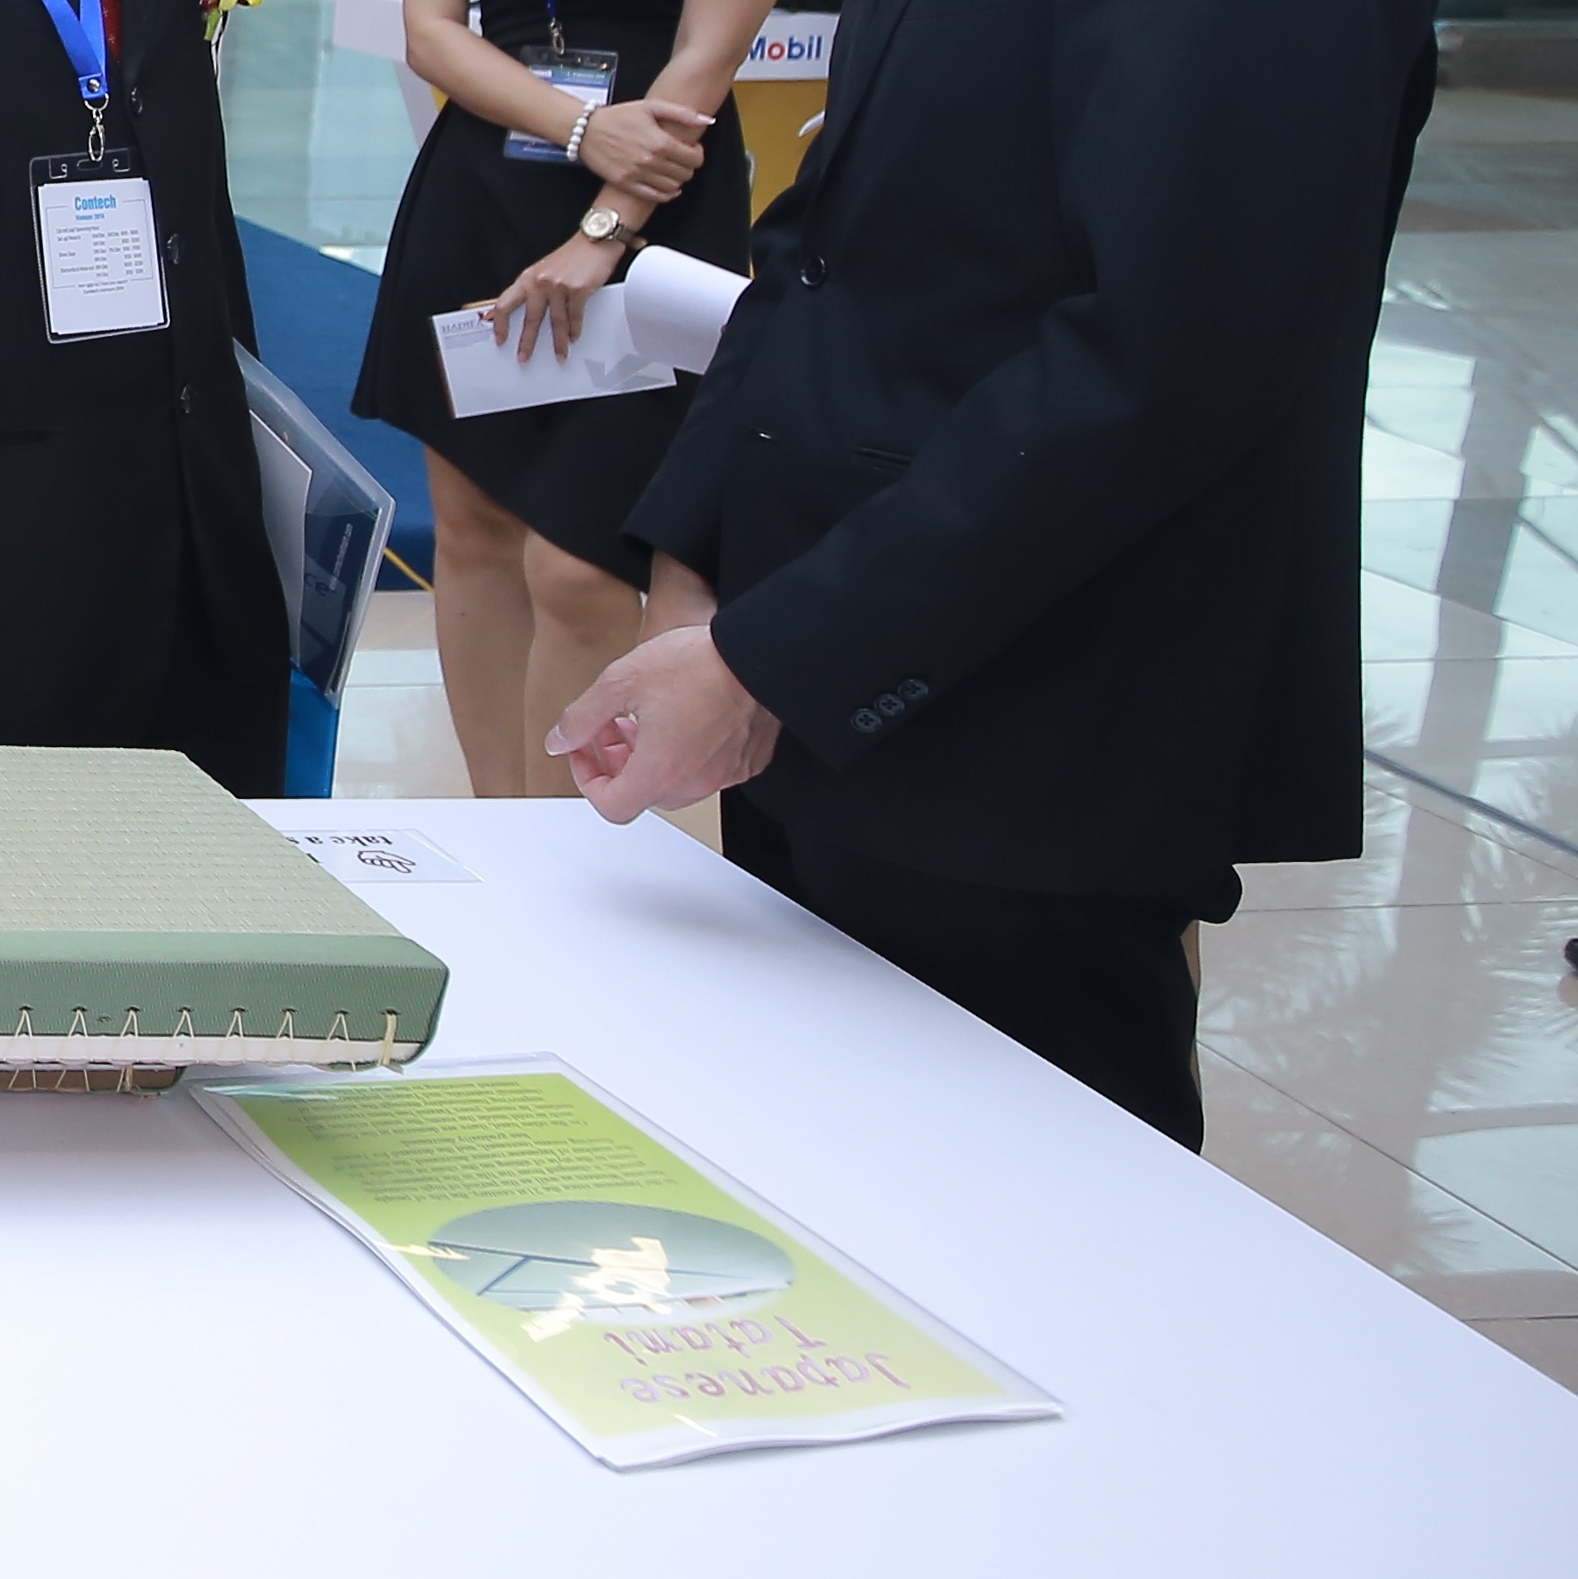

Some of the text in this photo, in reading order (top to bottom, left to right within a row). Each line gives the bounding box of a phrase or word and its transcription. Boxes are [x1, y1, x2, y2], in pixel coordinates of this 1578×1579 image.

[749, 35, 822, 60] Mobil
[74, 194, 117, 211] Contech
[304, 836, 323, 845] a
[329, 835, 393, 847] take
[603, 1314, 827, 1367] Tatami
[620, 1352, 911, 1403] Japanese
